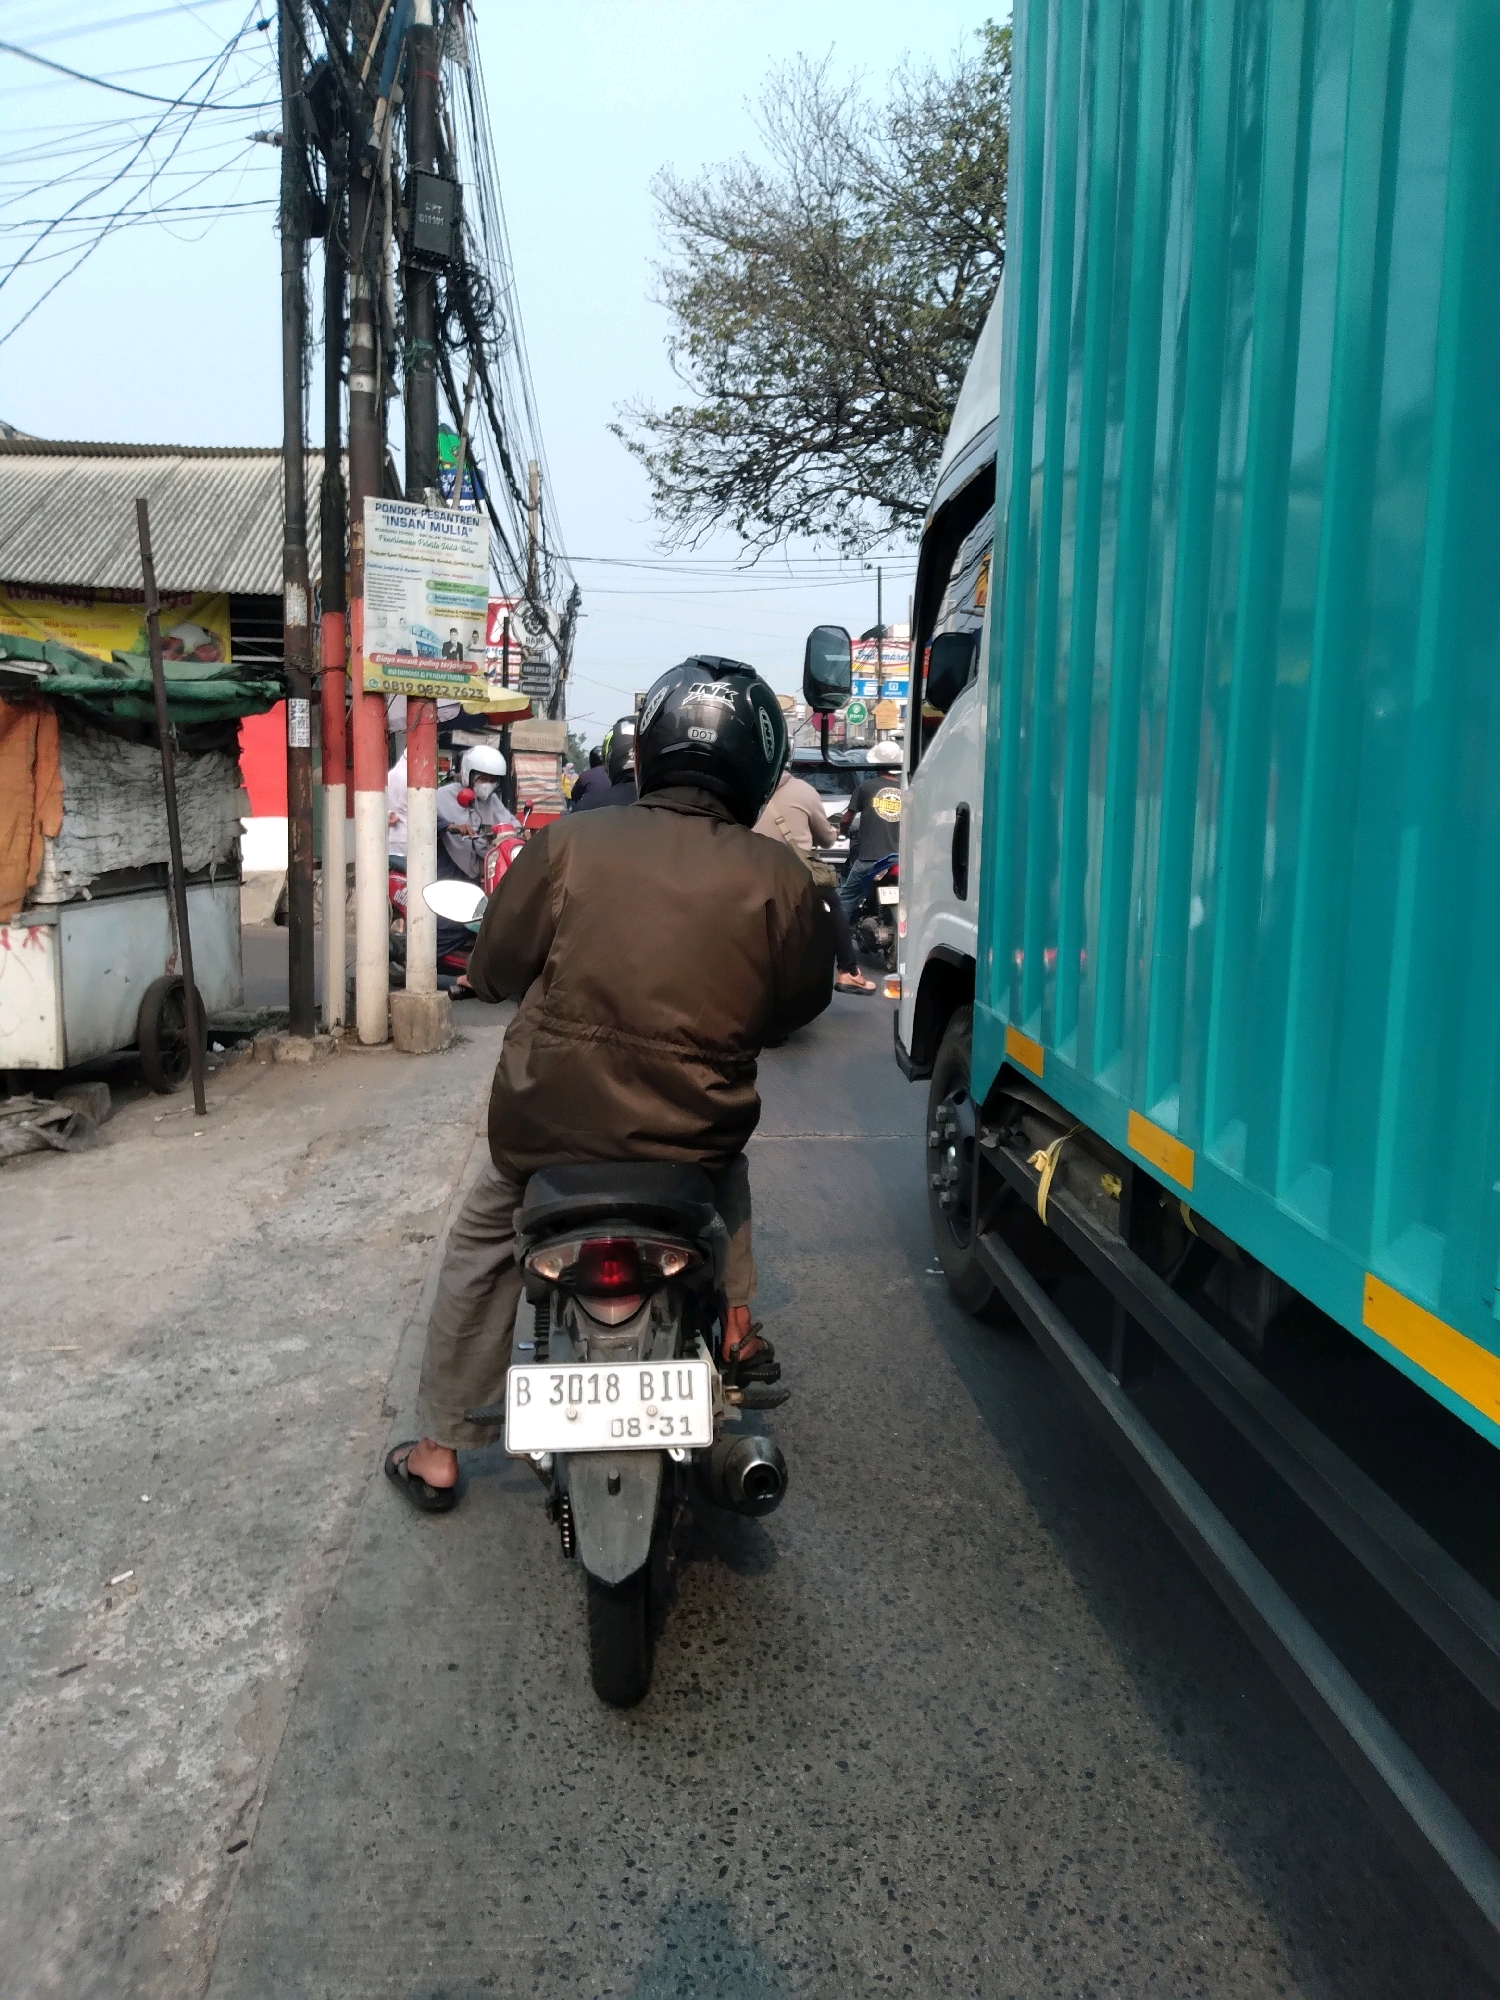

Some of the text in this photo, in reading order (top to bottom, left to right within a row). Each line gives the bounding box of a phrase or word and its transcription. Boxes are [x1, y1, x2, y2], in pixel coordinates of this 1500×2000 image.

[375, 502, 480, 526] PONDOK PESANTREN
[382, 680, 414, 691] 0819
[453, 687, 484, 698] 7623
[691, 730, 714, 739] DOT
[516, 1369, 694, 1406] B 3018 BIU
